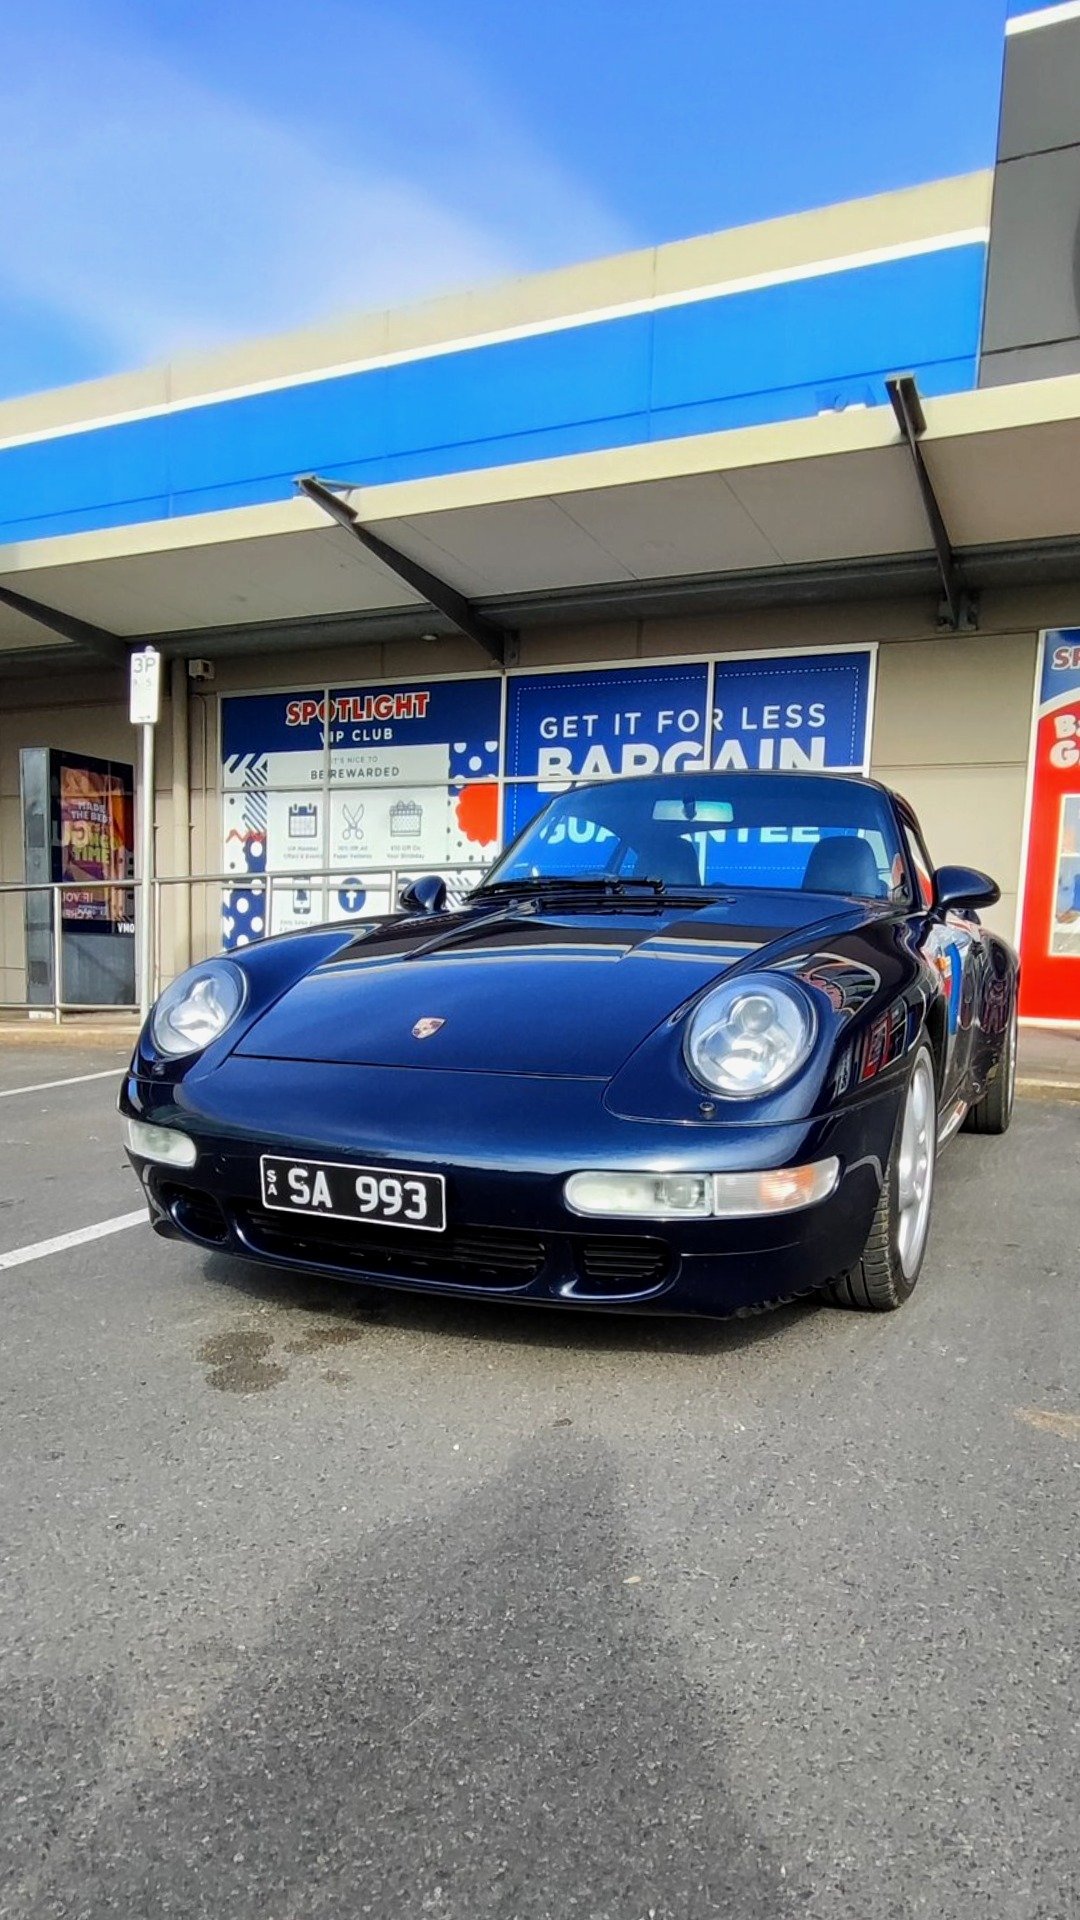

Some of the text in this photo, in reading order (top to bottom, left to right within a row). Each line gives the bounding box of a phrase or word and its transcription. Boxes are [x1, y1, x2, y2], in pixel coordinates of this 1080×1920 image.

[134, 657, 155, 673] 3P
[286, 691, 430, 726] SPOTLIGHT
[539, 703, 826, 739] GET IT FOR LESS
[352, 728, 393, 742] CLUB
[310, 766, 400, 780] BE REWARDED
[288, 1167, 428, 1220] SA 993
